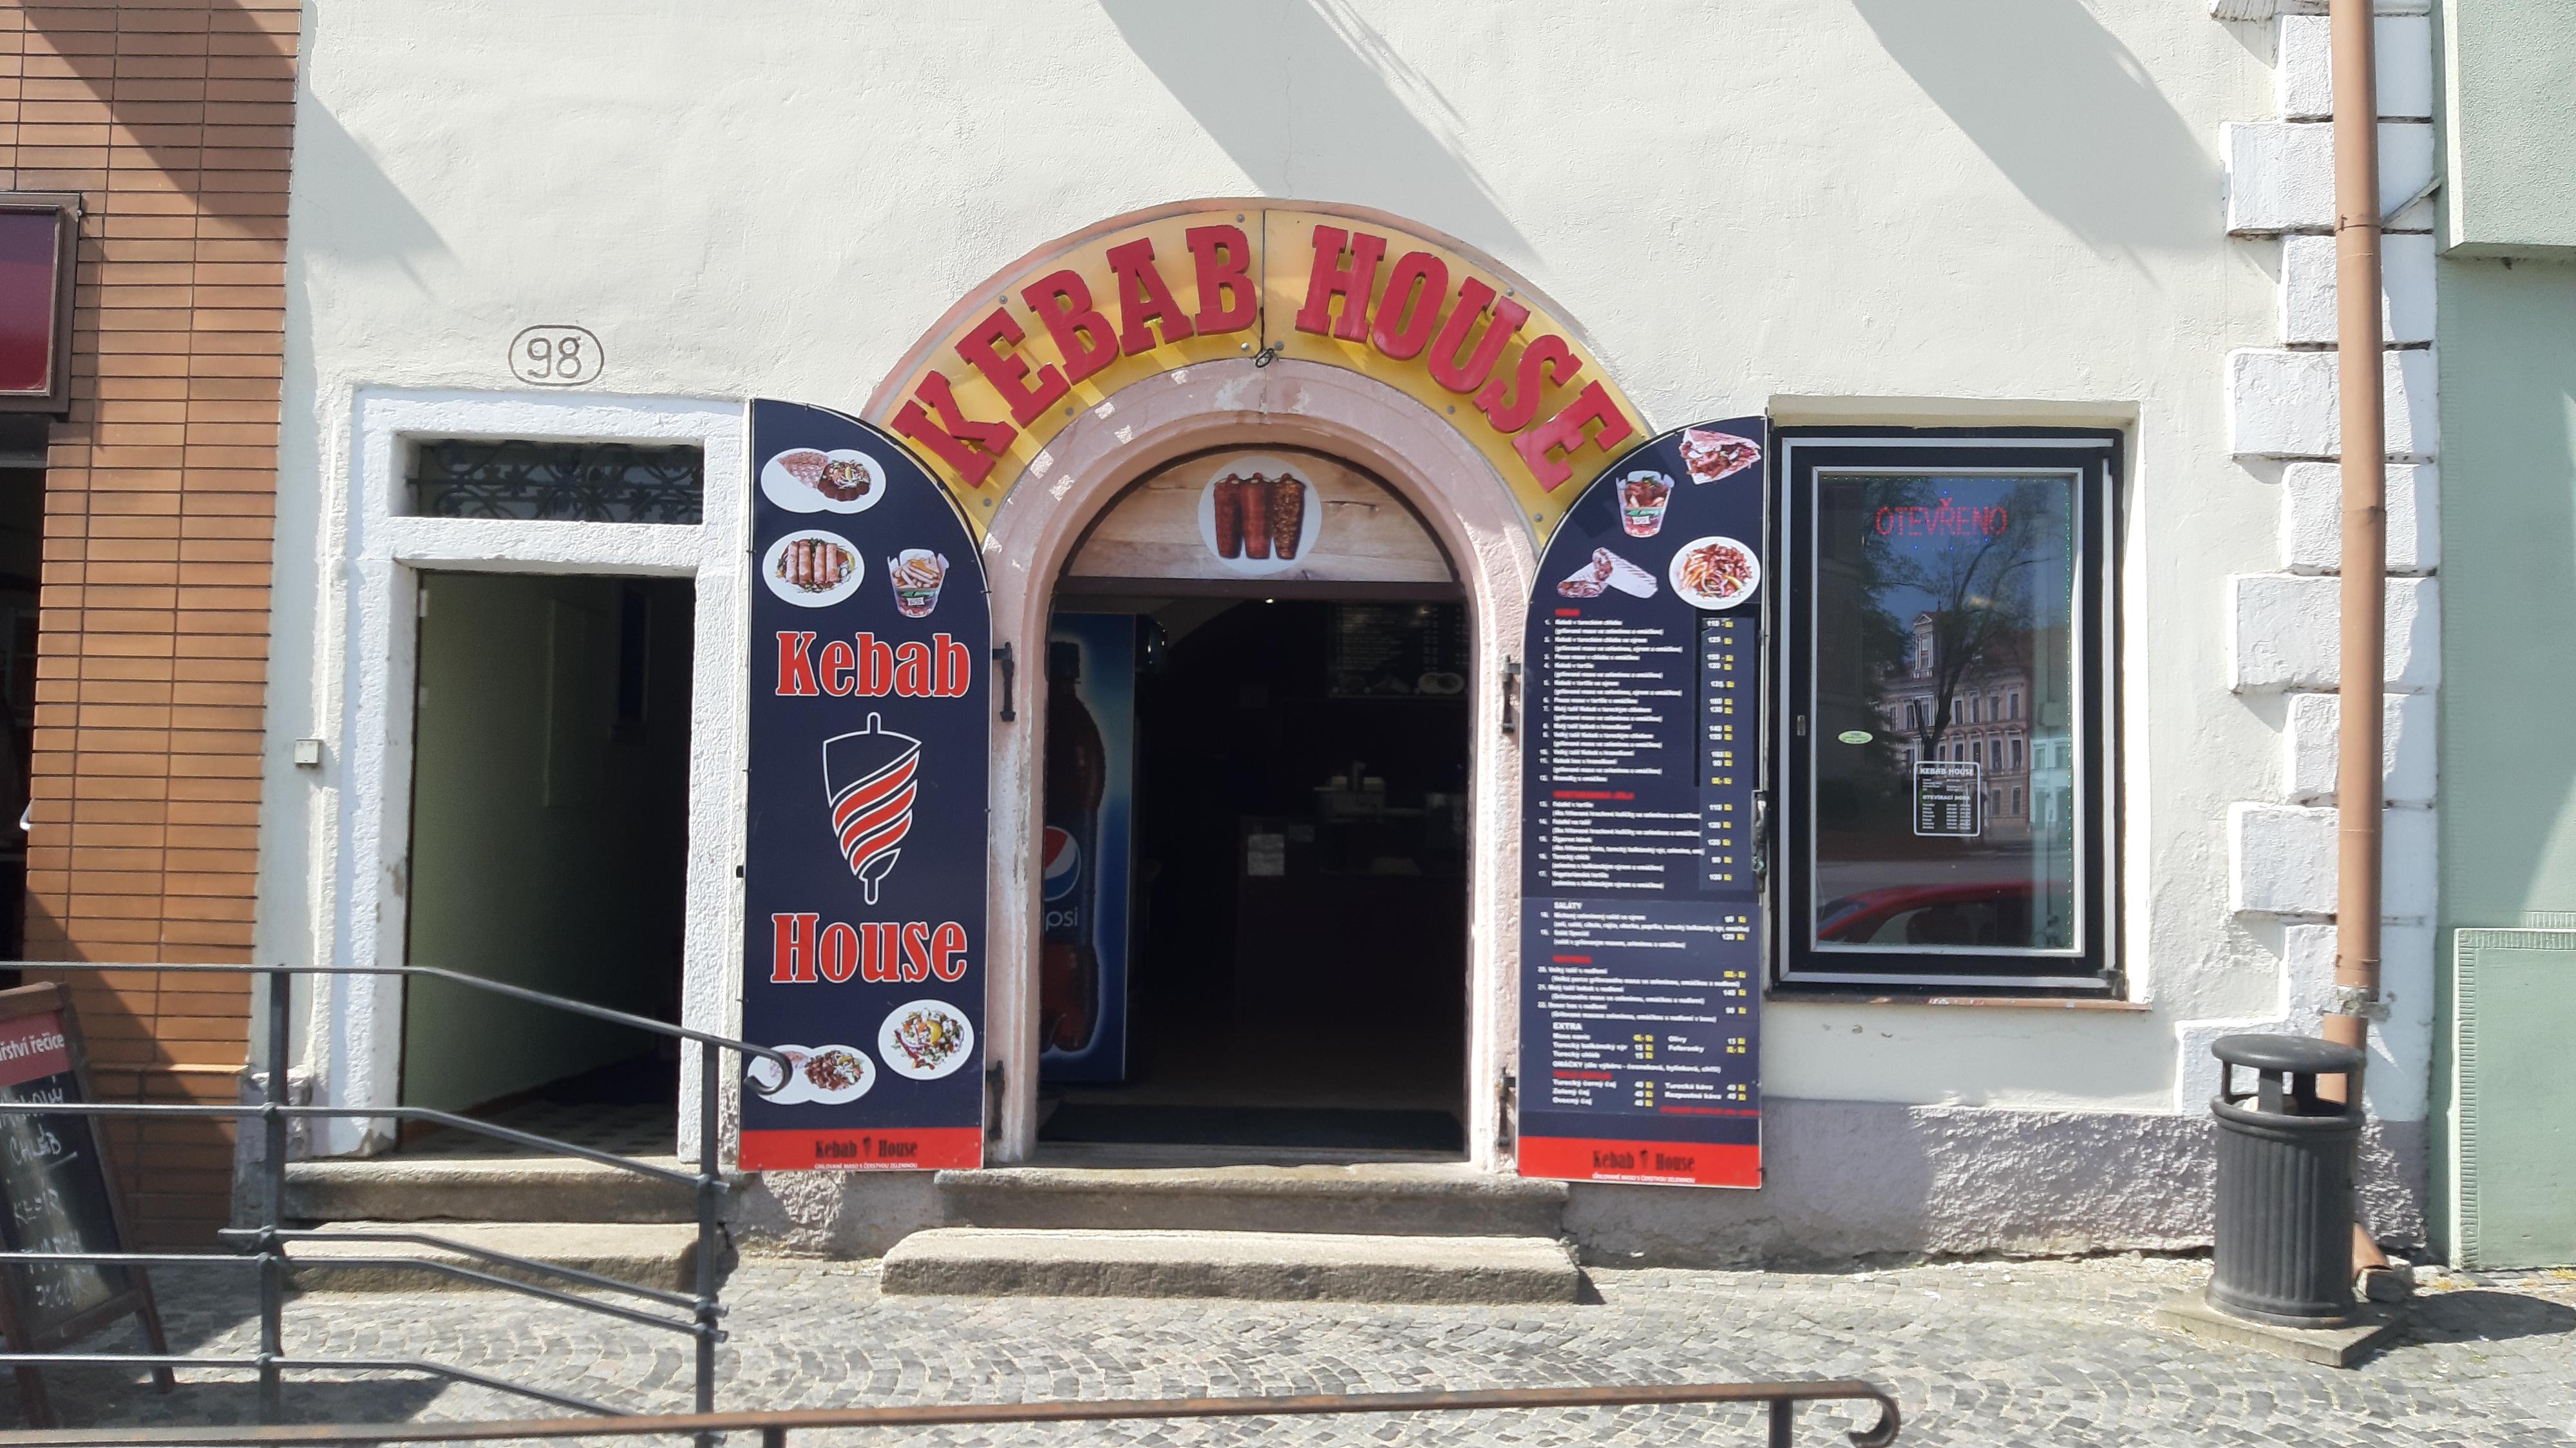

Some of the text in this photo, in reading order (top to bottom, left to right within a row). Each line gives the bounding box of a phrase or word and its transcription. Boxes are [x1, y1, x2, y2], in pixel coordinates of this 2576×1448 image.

[527, 336, 582, 378] 98
[890, 224, 1634, 493] KEBAB HOUSE
[1875, 497, 2008, 536] OTEVŘENO
[775, 631, 971, 698] Kebab
[1948, 768, 1974, 776] HOUSE
[1045, 907, 1078, 931] psi
[770, 912, 967, 984] House
[1552, 1022, 1583, 1031] EXTRA
[30, 1032, 64, 1054] řečice
[815, 1139, 918, 1158] Kebab House
[1593, 1150, 1695, 1171] Kebab House
